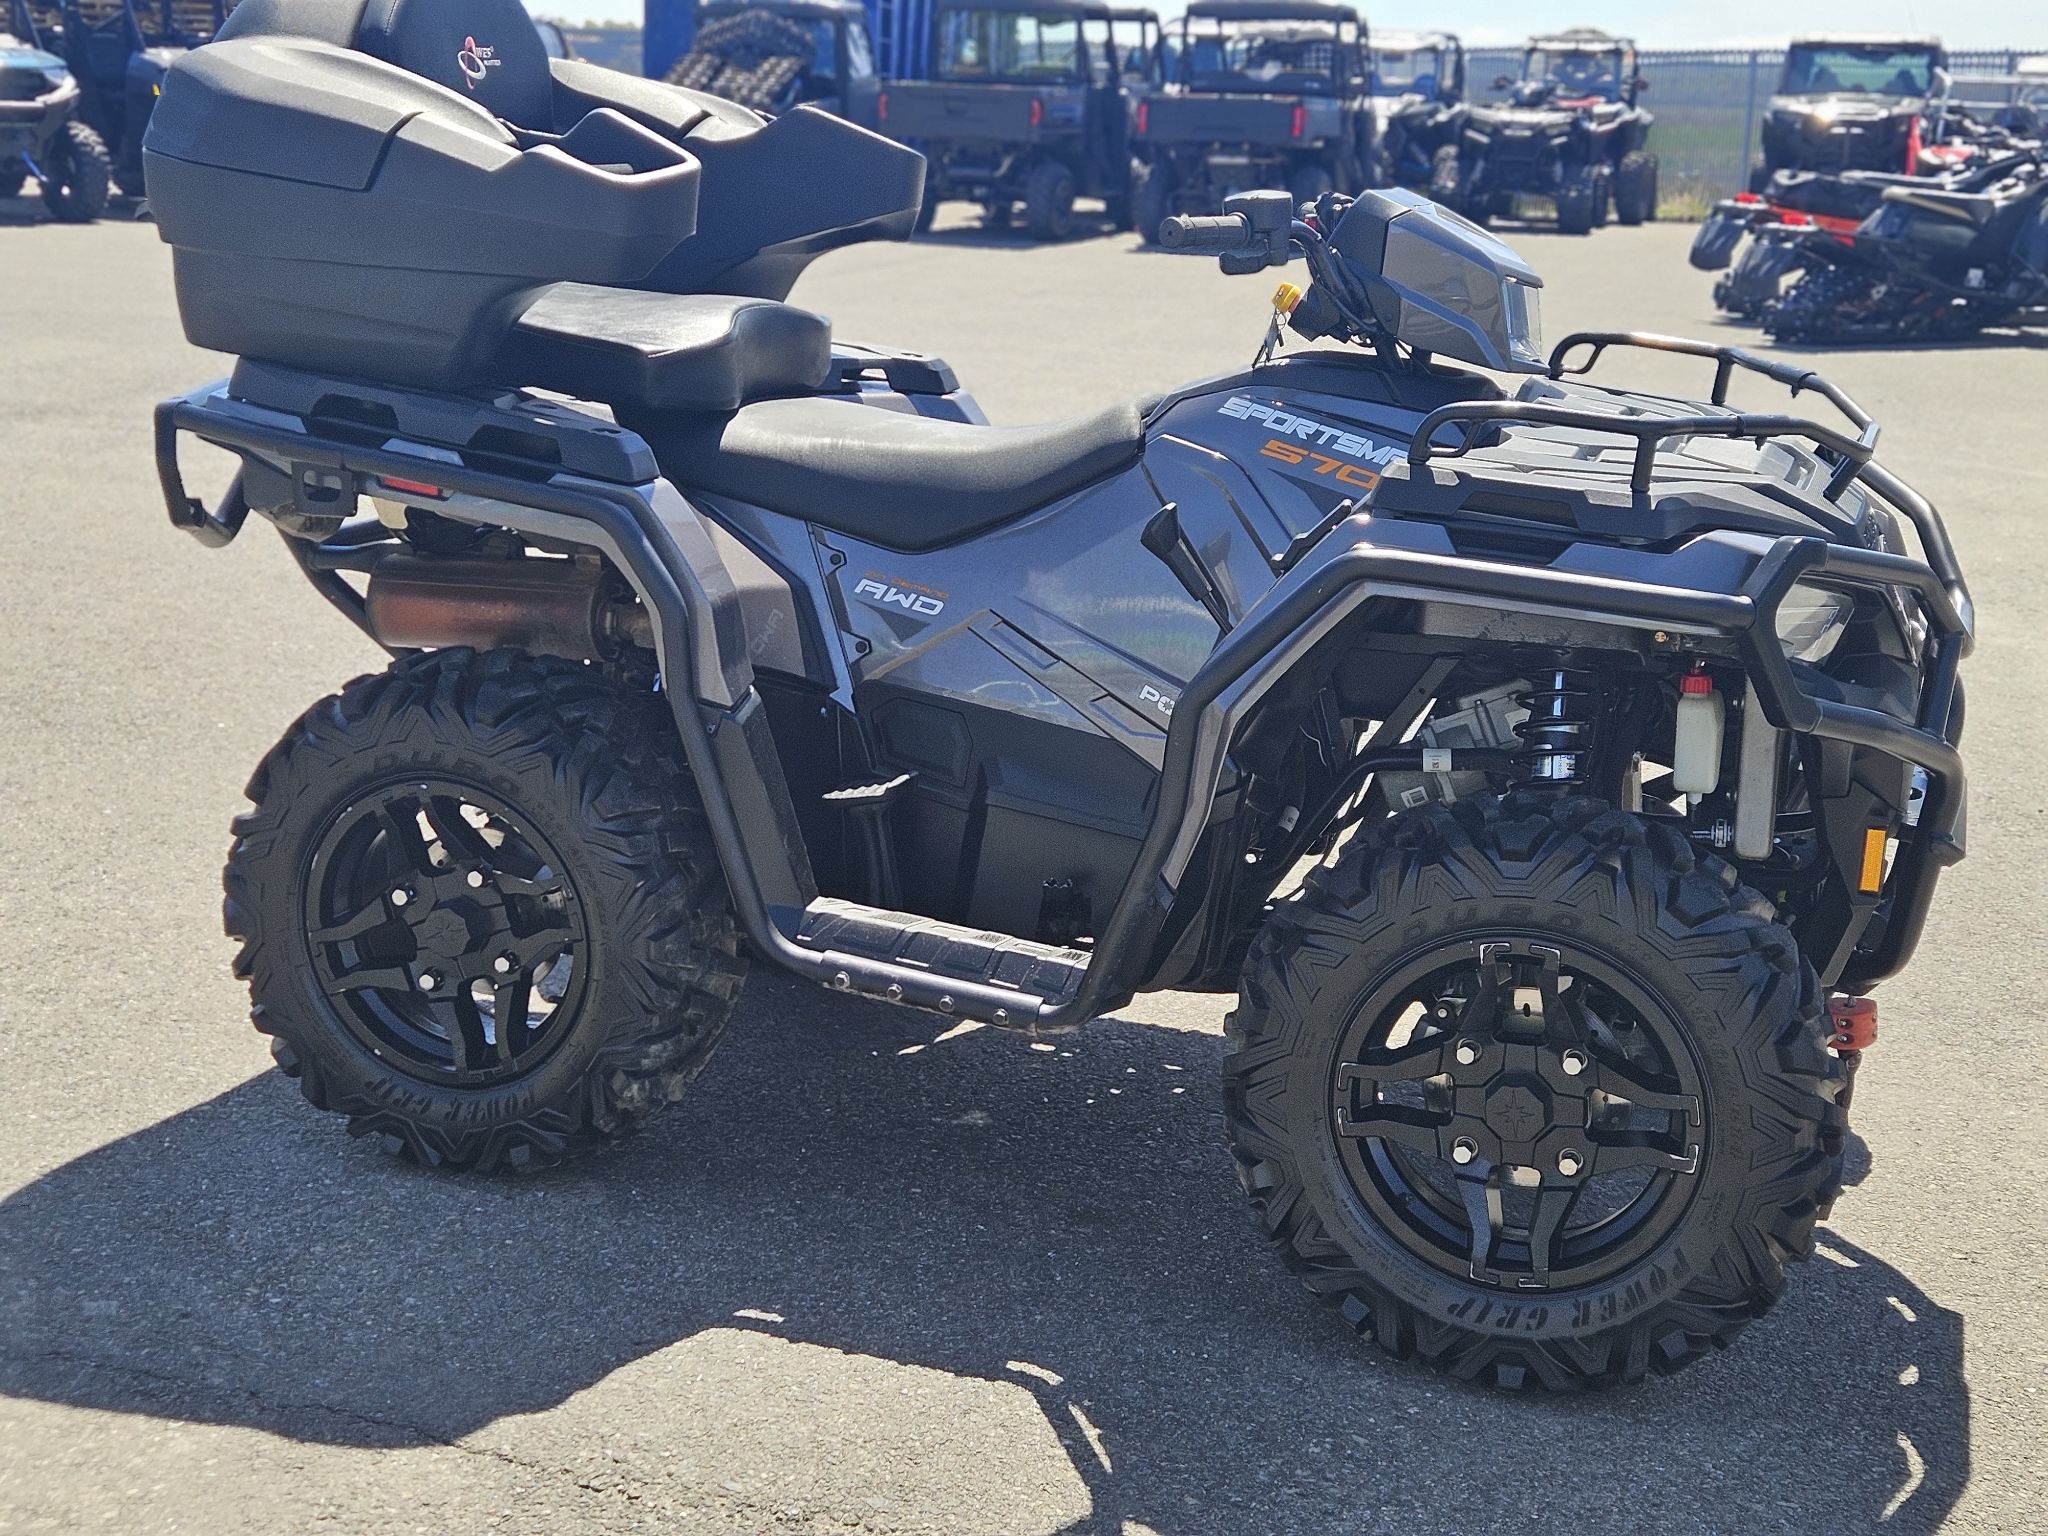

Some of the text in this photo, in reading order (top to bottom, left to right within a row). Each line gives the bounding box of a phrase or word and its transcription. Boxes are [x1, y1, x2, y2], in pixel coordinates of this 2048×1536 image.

[1217, 396, 1409, 466] SPORTSMA
[1260, 439, 1382, 490] 570
[854, 578, 944, 616] AWD
[373, 750, 522, 796] DURO
[1402, 904, 1584, 945] DURO
[363, 1076, 537, 1122] POWER GRIP
[1446, 1246, 1693, 1331] POWER GRIP
